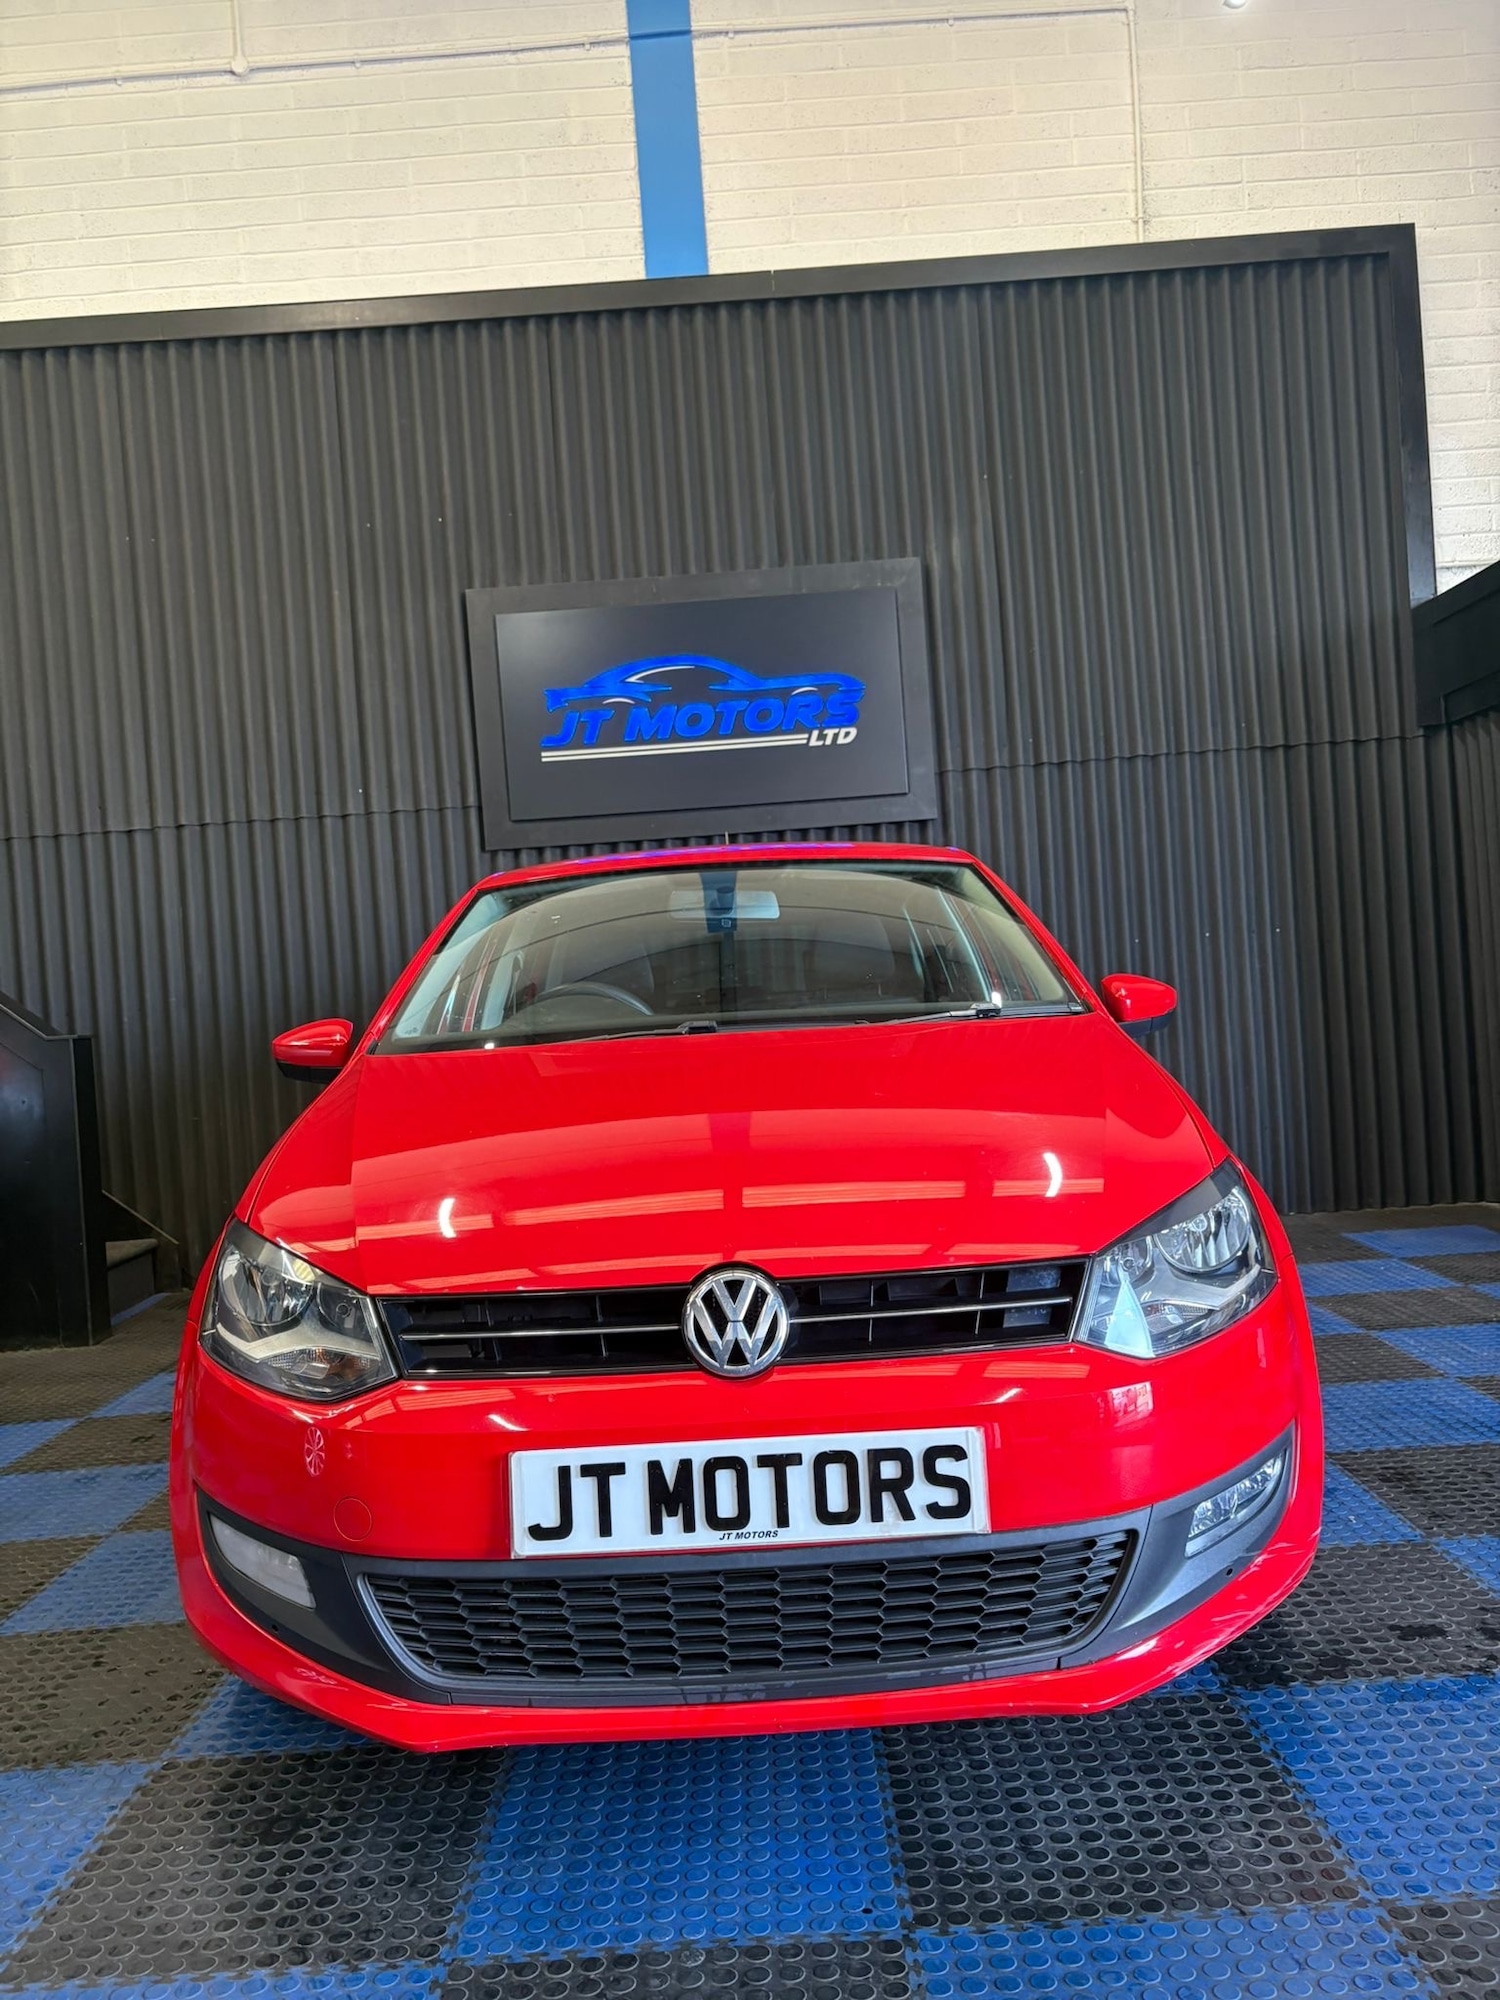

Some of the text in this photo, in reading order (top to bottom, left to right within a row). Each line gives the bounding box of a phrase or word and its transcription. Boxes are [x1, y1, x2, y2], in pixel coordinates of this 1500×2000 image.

[541, 691, 865, 747] JT MOTORS
[808, 726, 858, 747] LTD
[528, 1445, 971, 1541] JT MOTORS
[719, 1529, 779, 1541] JT MOTORS
